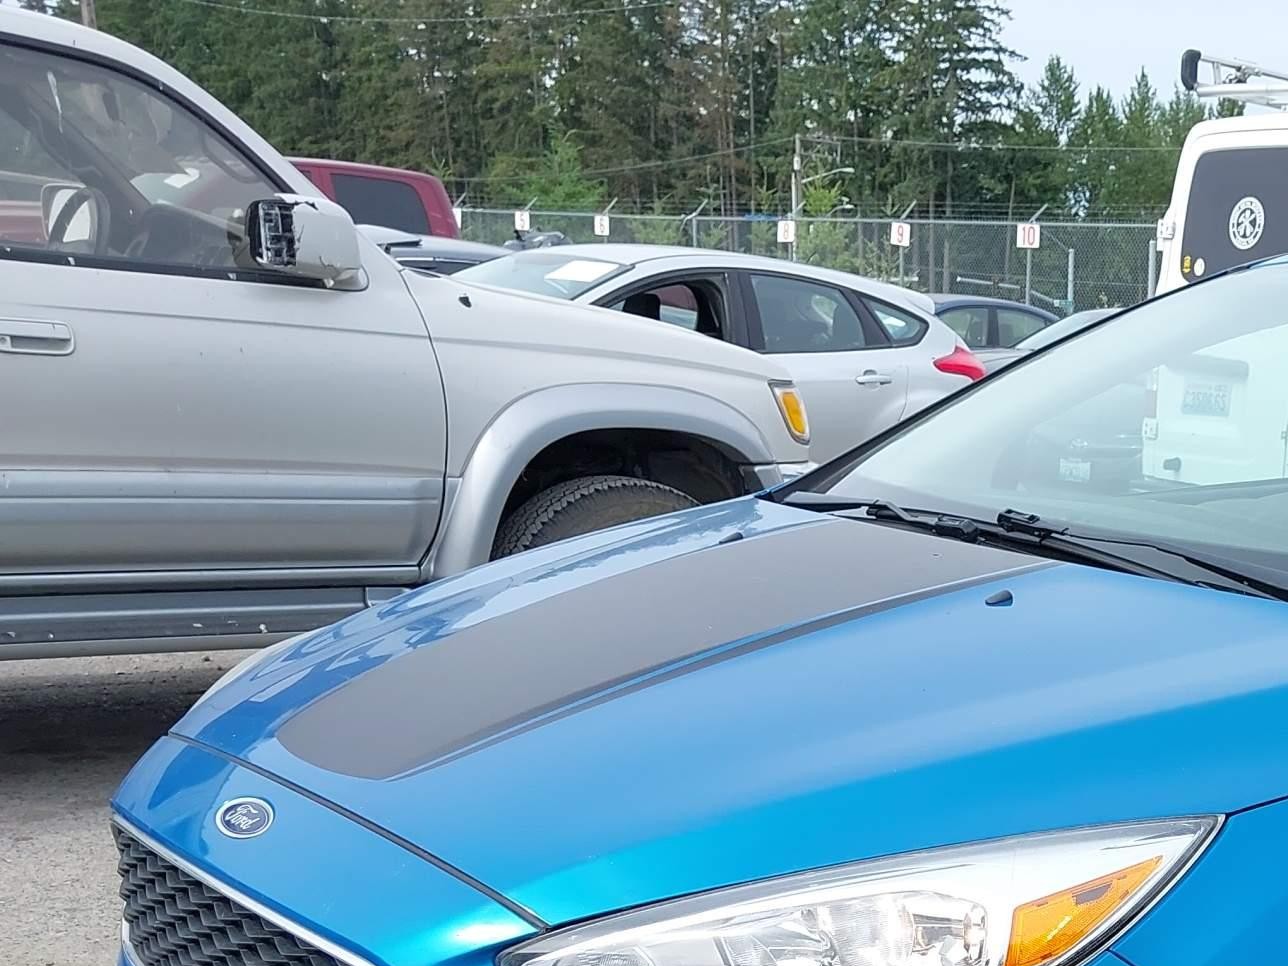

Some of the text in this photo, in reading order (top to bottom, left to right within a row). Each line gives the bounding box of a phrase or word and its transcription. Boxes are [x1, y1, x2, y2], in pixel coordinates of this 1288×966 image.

[783, 222, 790, 241] 8
[897, 224, 904, 244] 9
[1022, 226, 1036, 246] 10
[223, 803, 262, 831] Ford
